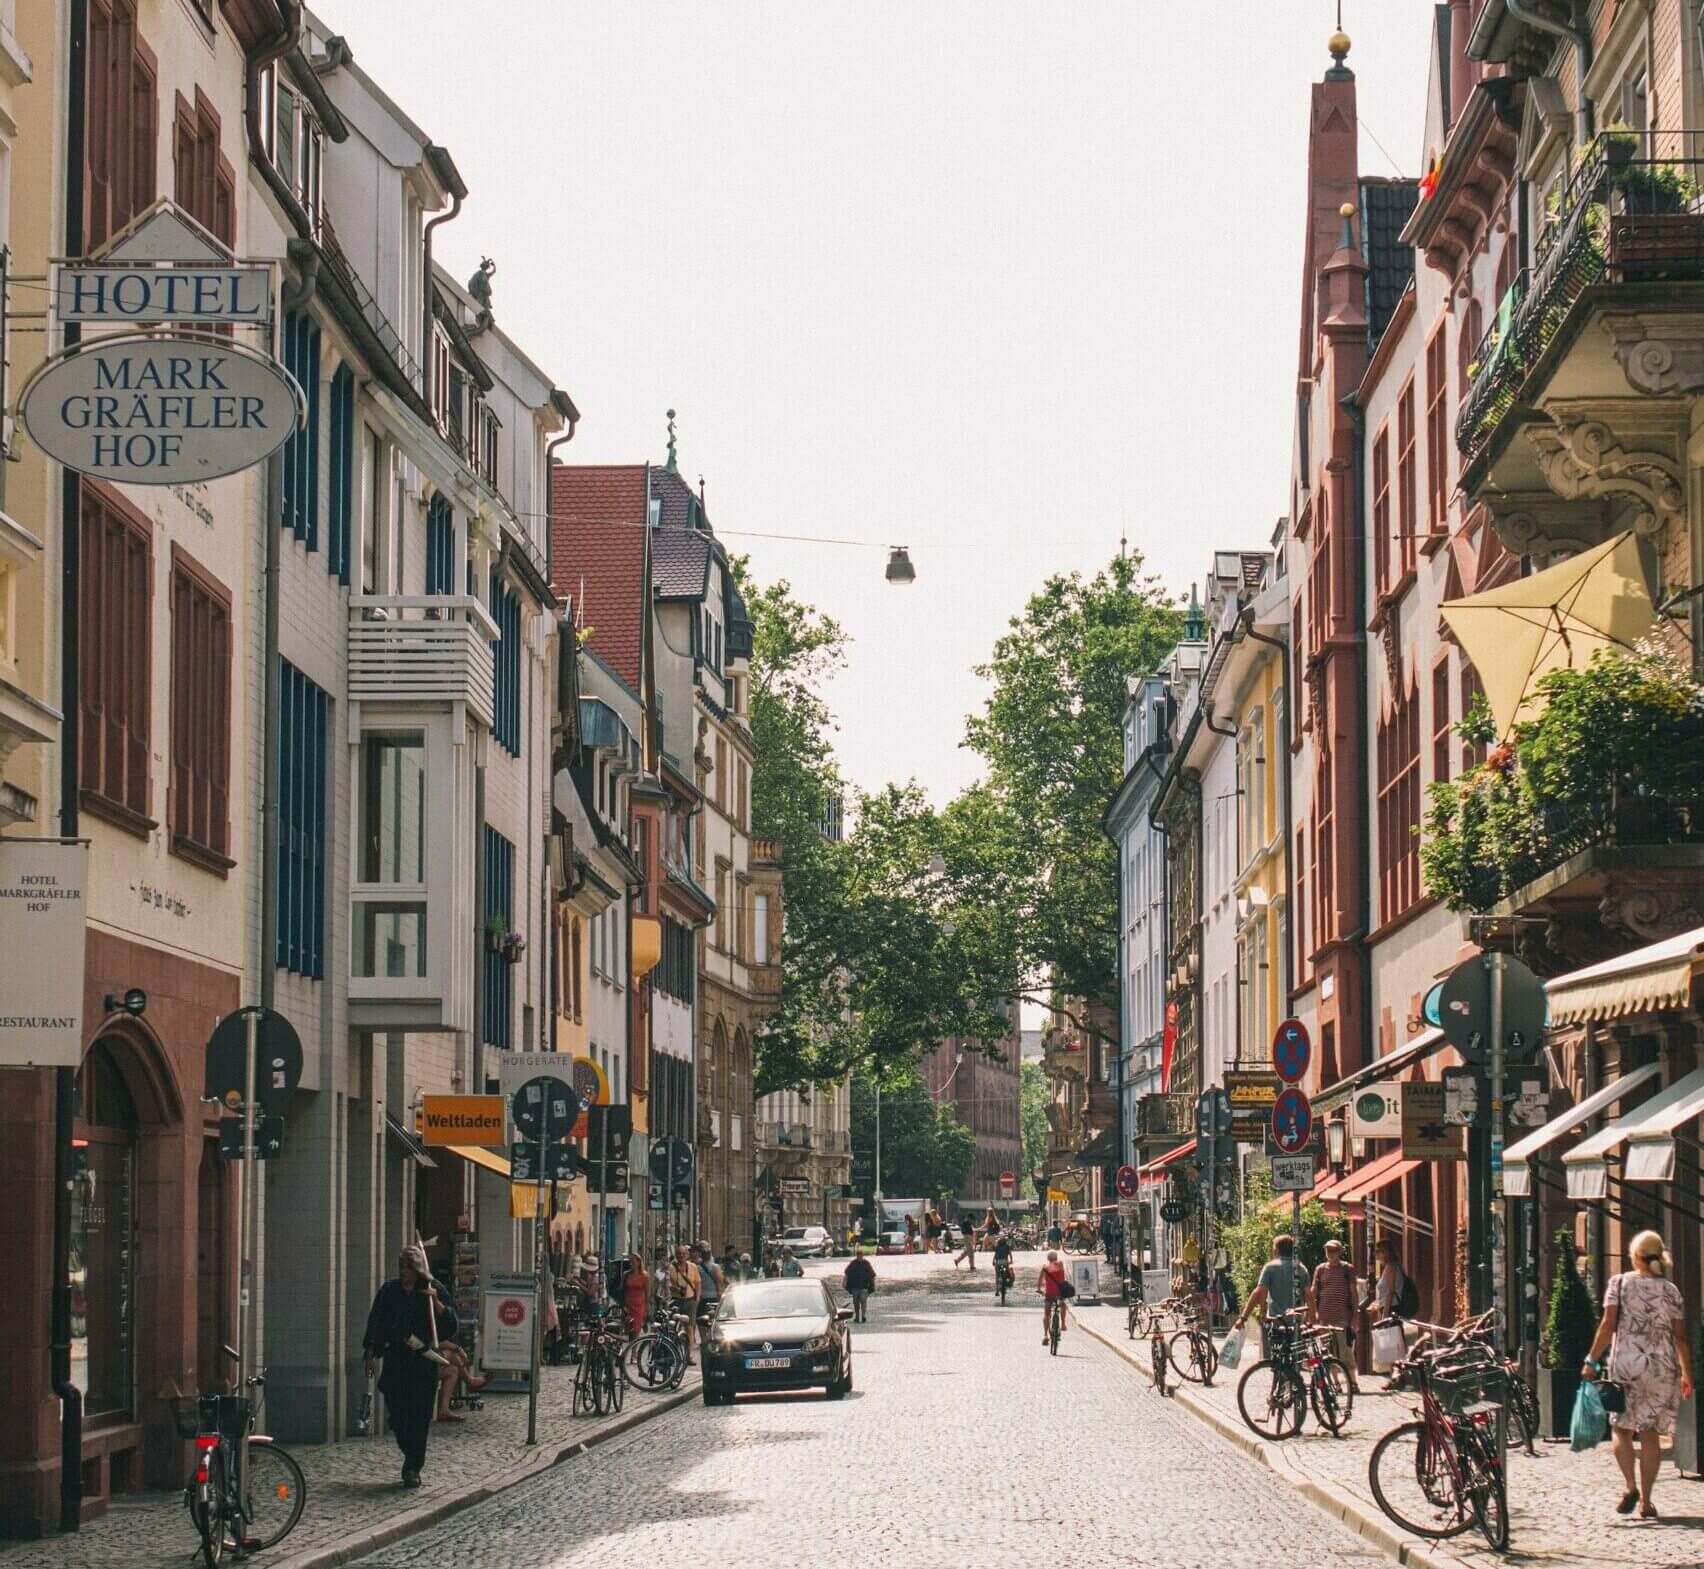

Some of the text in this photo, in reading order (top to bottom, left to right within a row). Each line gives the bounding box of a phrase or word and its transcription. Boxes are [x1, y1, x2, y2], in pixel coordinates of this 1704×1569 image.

[69, 274, 260, 314] HOTEL
[93, 357, 229, 390] MARK
[60, 393, 268, 430] GRÄFLER
[91, 434, 183, 467] HOF
[20, 875, 58, 886] HOTEL
[26, 902, 51, 912] HOF
[426, 1114, 501, 1129] Weltladen
[1274, 1160, 1311, 1173] werktags
